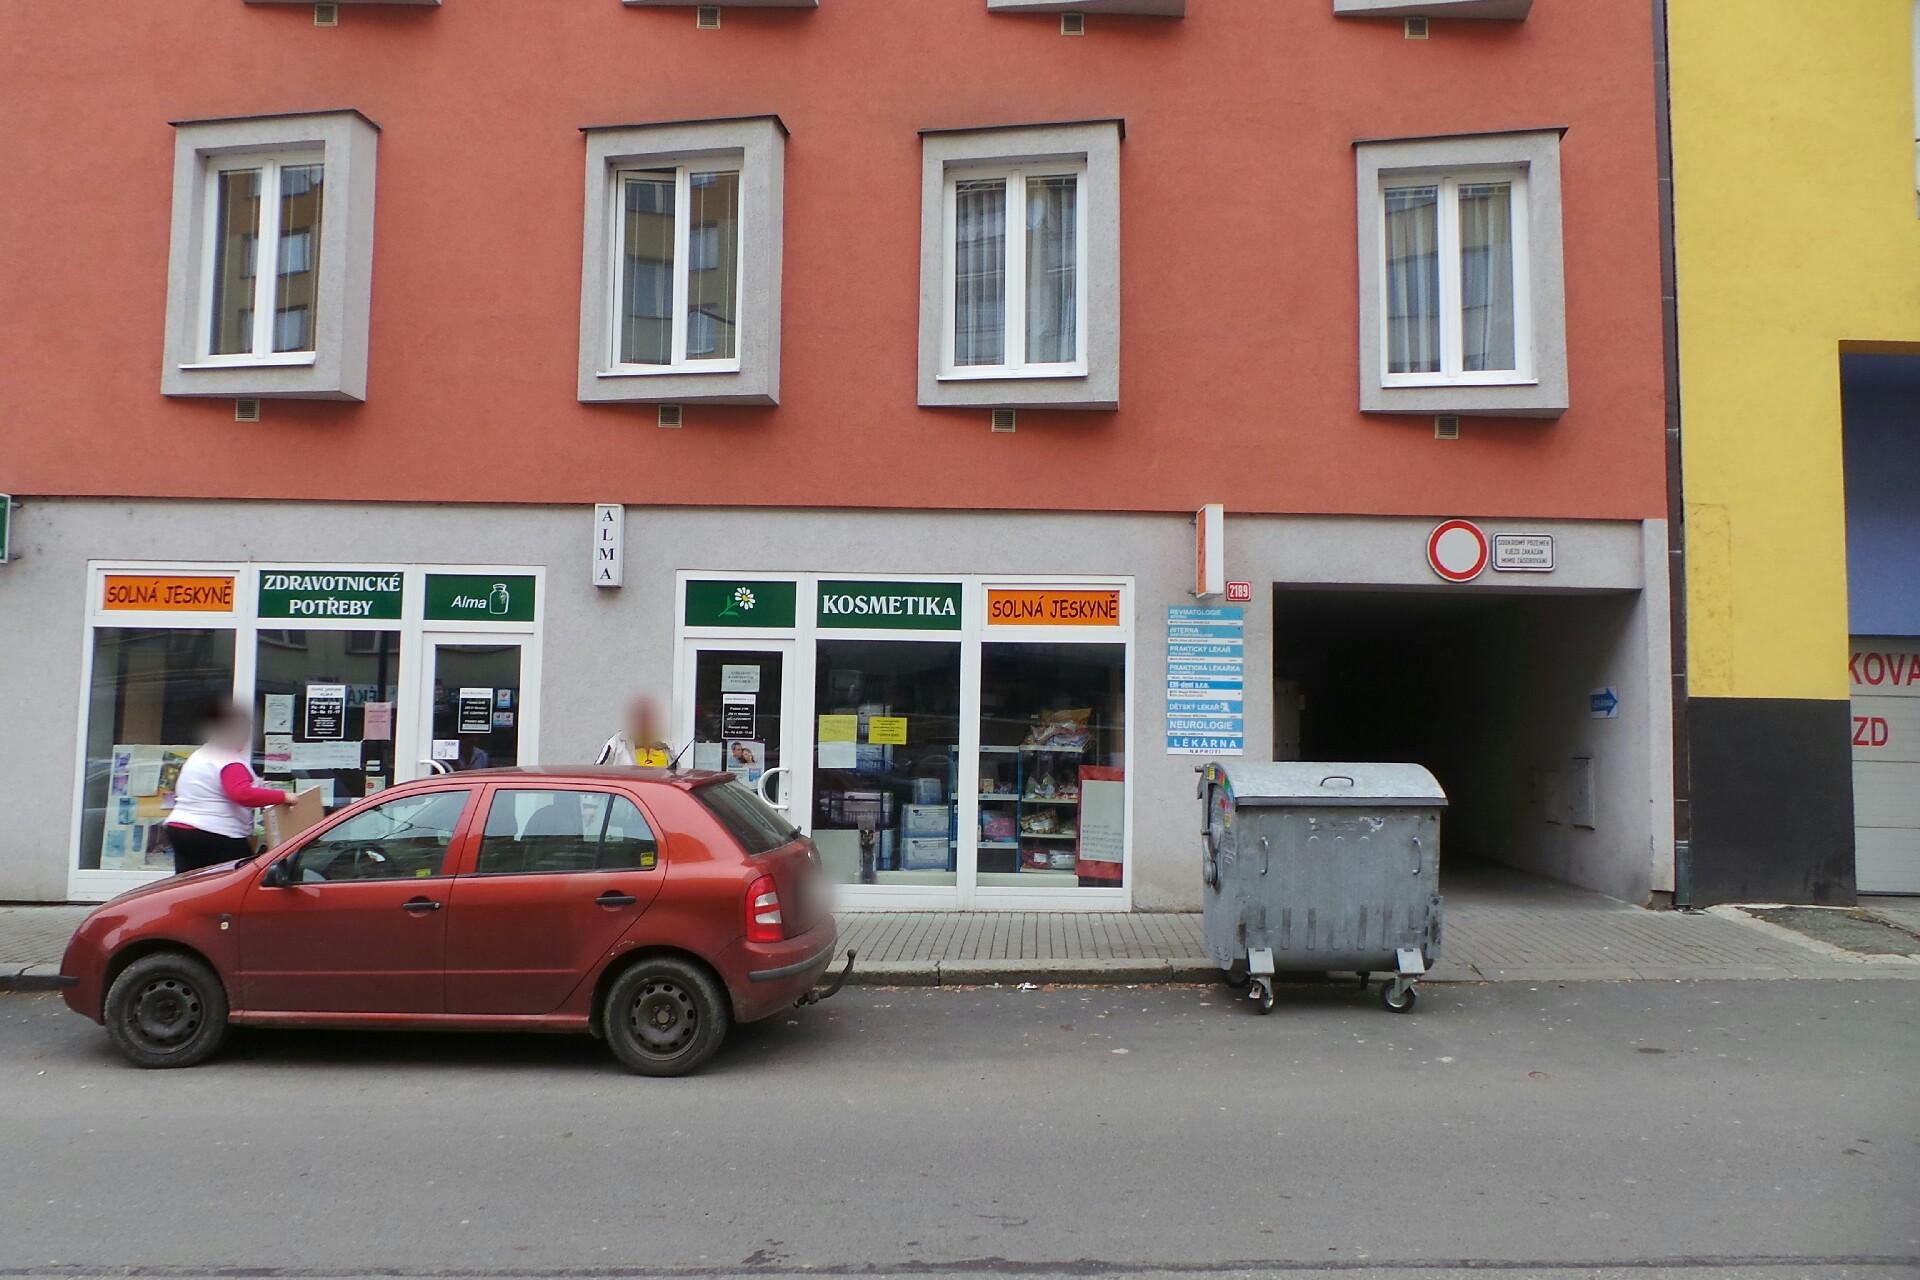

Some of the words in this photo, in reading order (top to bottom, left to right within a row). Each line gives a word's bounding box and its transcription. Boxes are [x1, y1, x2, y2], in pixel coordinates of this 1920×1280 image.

[598, 509, 614, 580] ALMA
[264, 573, 400, 592] ZDRAVOTNICKÉ
[107, 581, 158, 604] SOLNÁ
[164, 580, 233, 605] JESKYNĚ
[289, 597, 373, 616] POTŘEBY
[451, 596, 487, 609] Alma
[822, 594, 956, 616] KOSMETIKA
[991, 596, 1044, 618] SOLNÁ
[1050, 594, 1118, 619] JESKYNĚ
[1169, 720, 1233, 729] NEUROLOGIE
[1173, 737, 1237, 748] LÉKÁRNA
